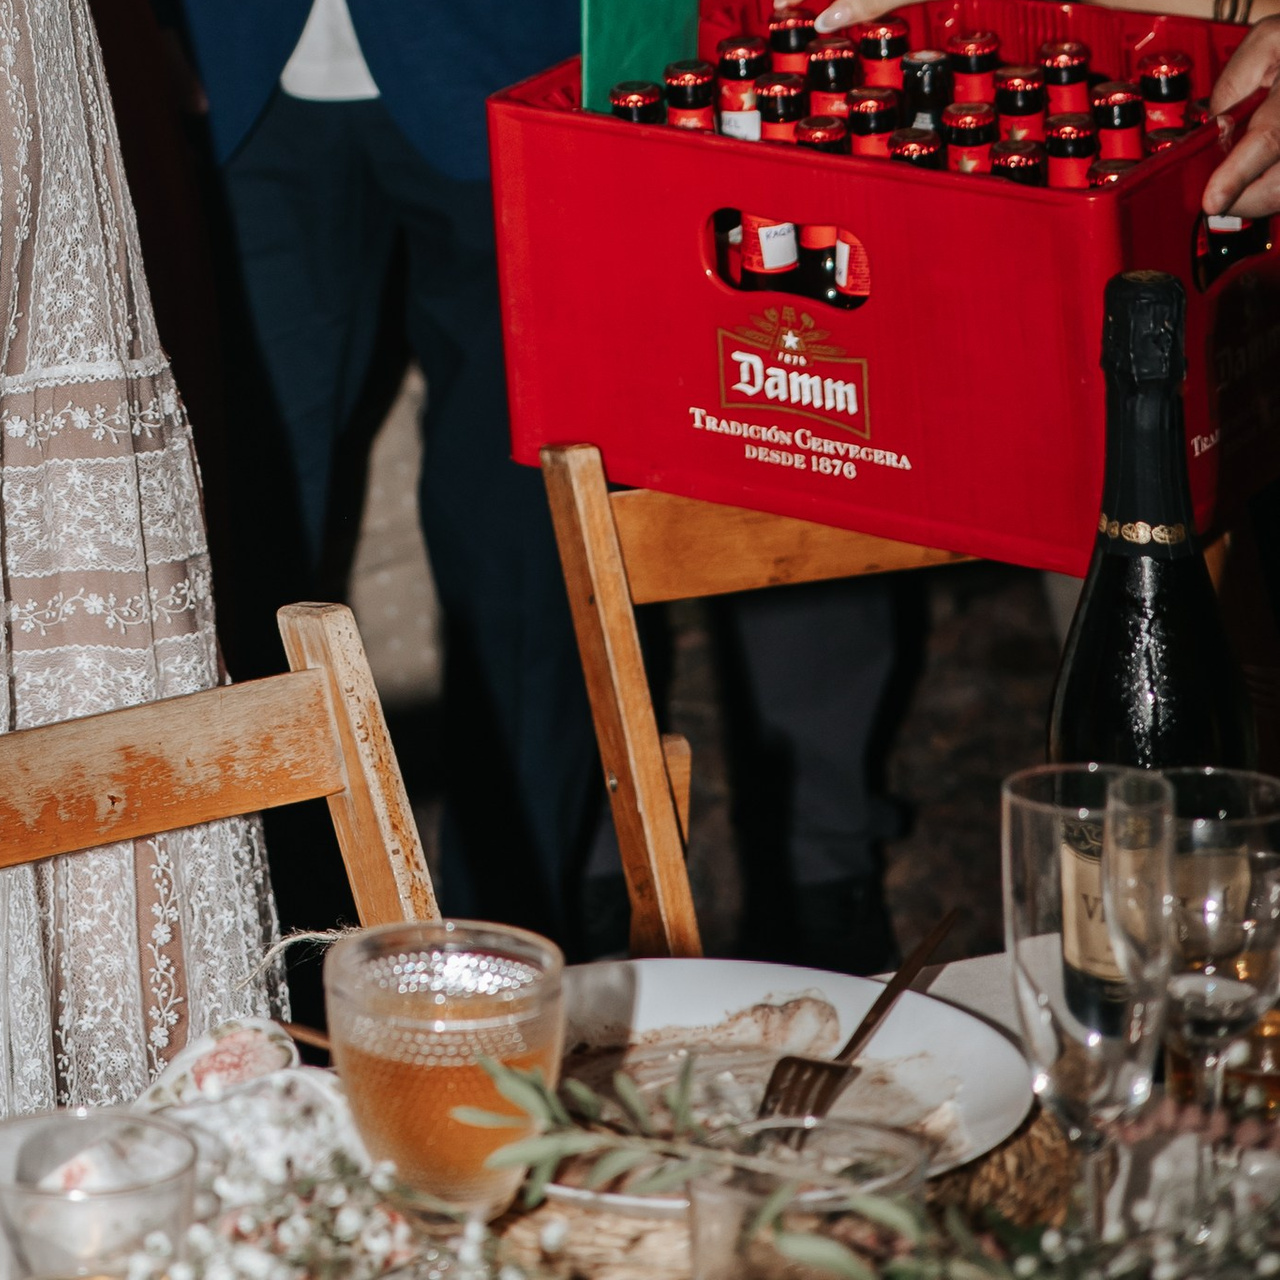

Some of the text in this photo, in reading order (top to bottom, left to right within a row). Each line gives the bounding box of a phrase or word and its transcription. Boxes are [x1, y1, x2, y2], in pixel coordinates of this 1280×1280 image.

[777, 351, 808, 367] 1876
[731, 350, 859, 416] Damm
[744, 444, 858, 481] DESDE 1876
